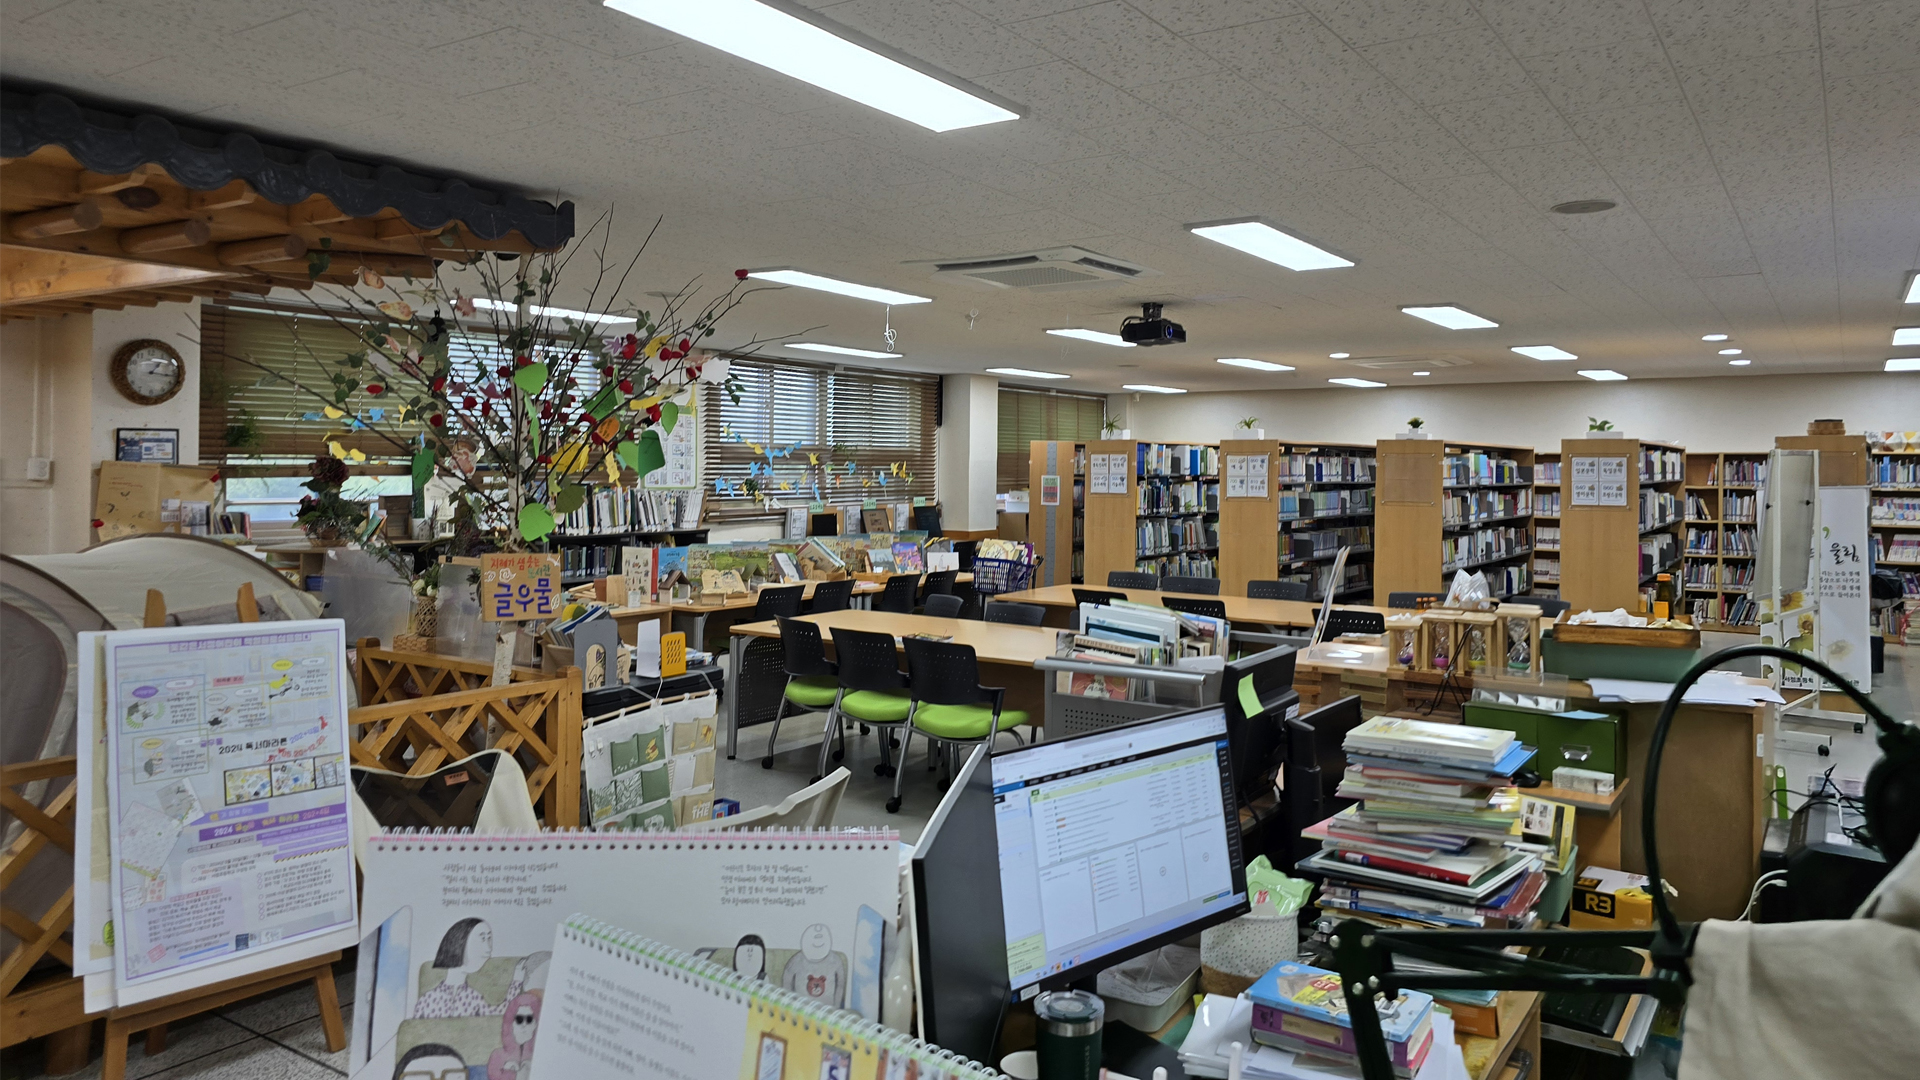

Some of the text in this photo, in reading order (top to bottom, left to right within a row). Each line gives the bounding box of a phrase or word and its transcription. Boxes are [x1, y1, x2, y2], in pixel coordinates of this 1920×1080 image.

[1830, 542, 1860, 565] 울림
[527, 564, 551, 579] 도서관
[493, 578, 552, 617] 글우물
[1105, 644, 1136, 654] HAWKING
[245, 737, 288, 751] 독서마라톤
[692, 806, 710, 820] THE
[214, 826, 234, 837] 2024
[1585, 893, 1612, 914] R3
